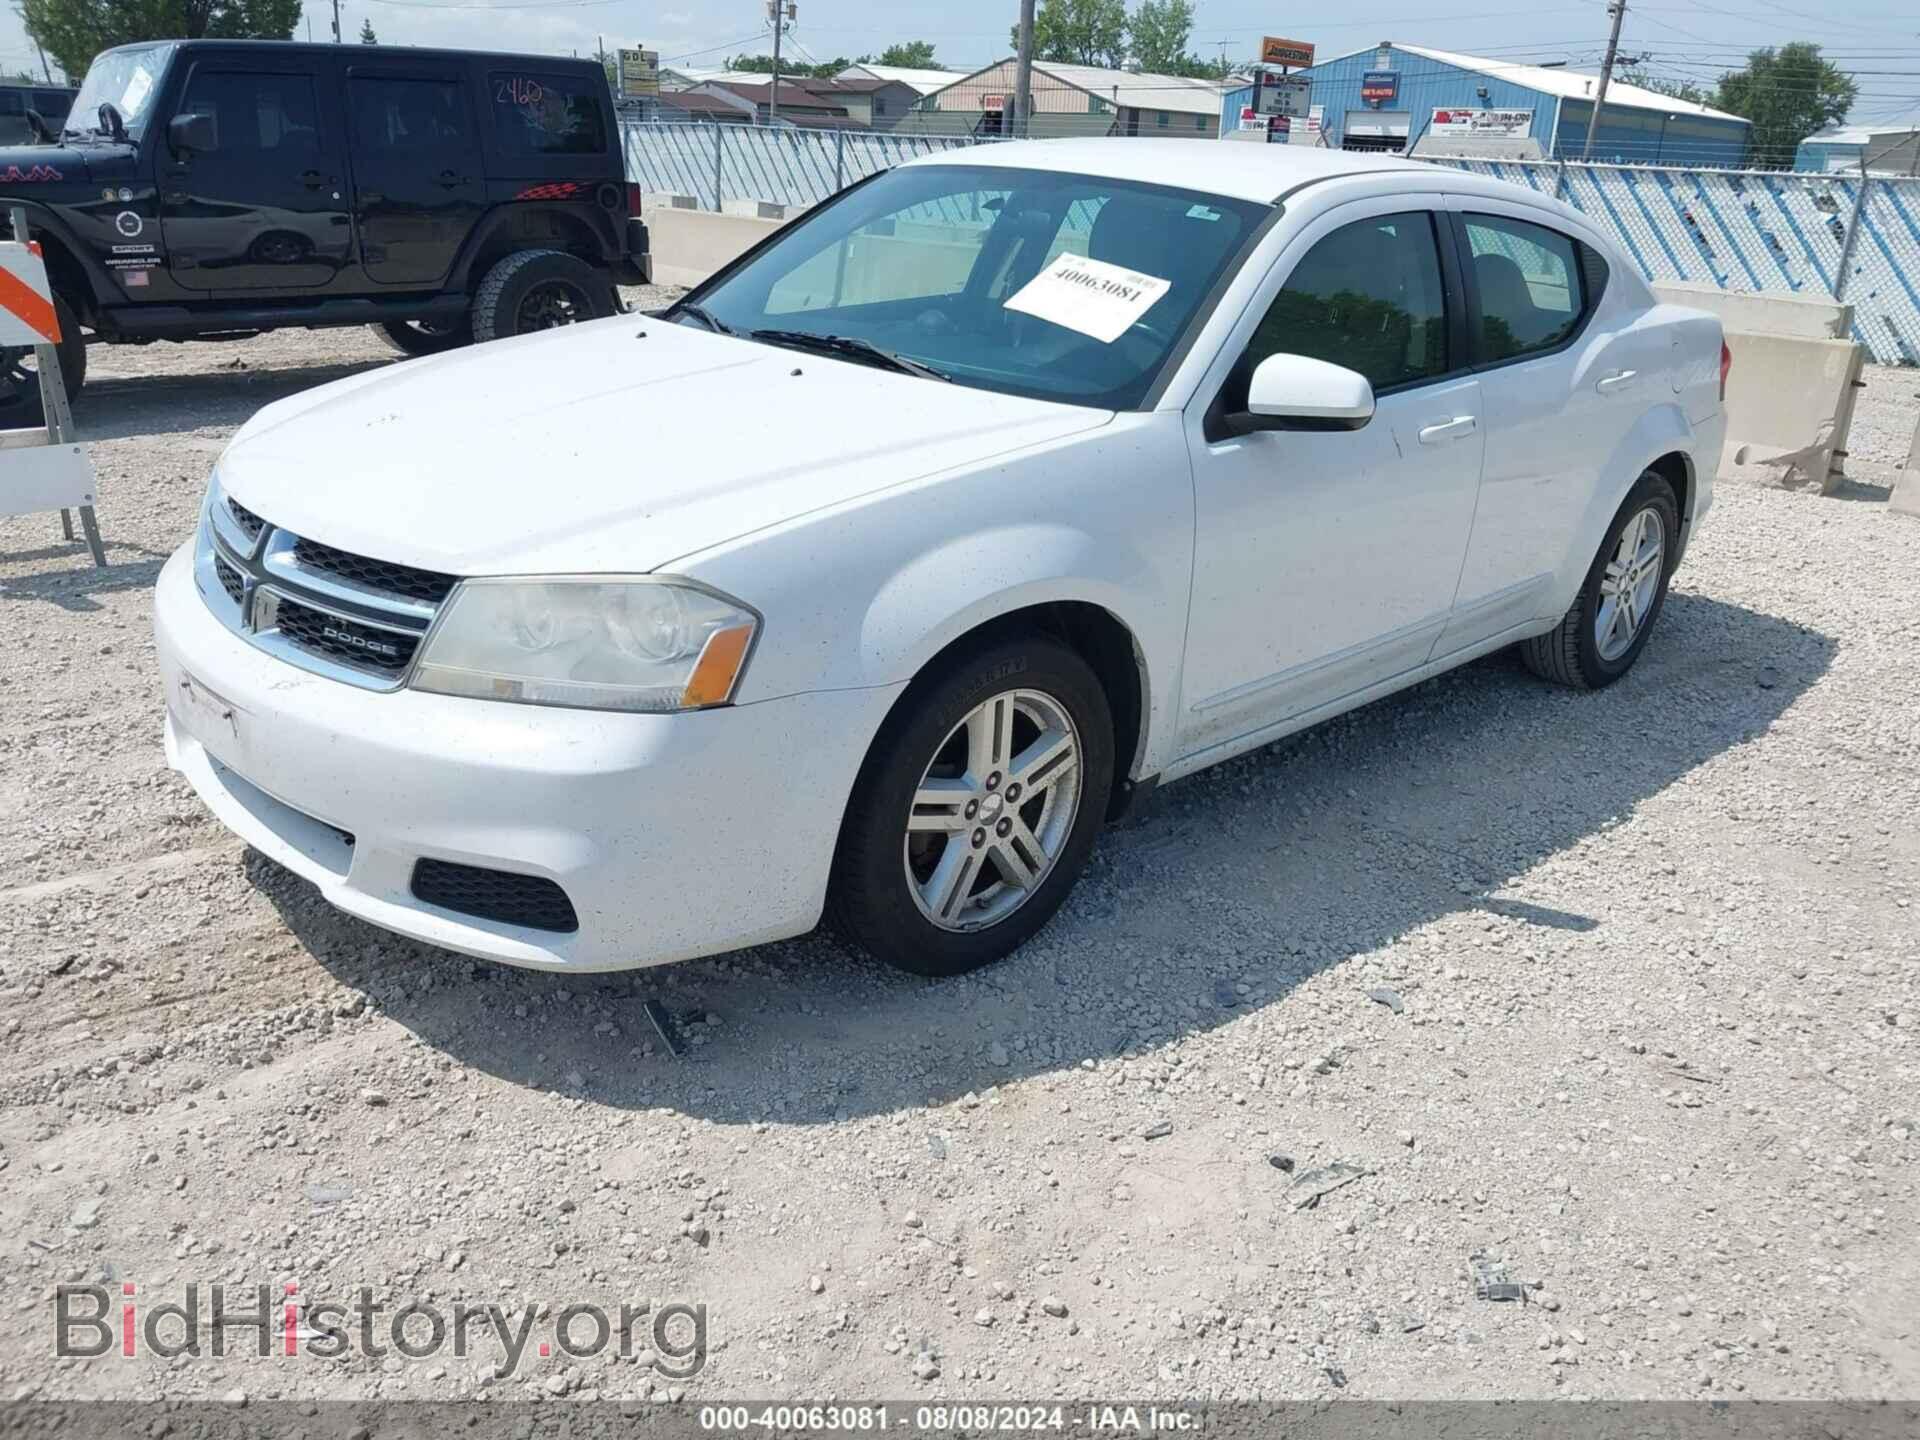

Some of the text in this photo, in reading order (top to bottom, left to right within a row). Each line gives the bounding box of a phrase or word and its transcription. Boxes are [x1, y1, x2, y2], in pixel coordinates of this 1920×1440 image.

[497, 78, 543, 104] 2460
[1055, 268, 1142, 303] 40063081
[323, 626, 398, 655] DODGE
